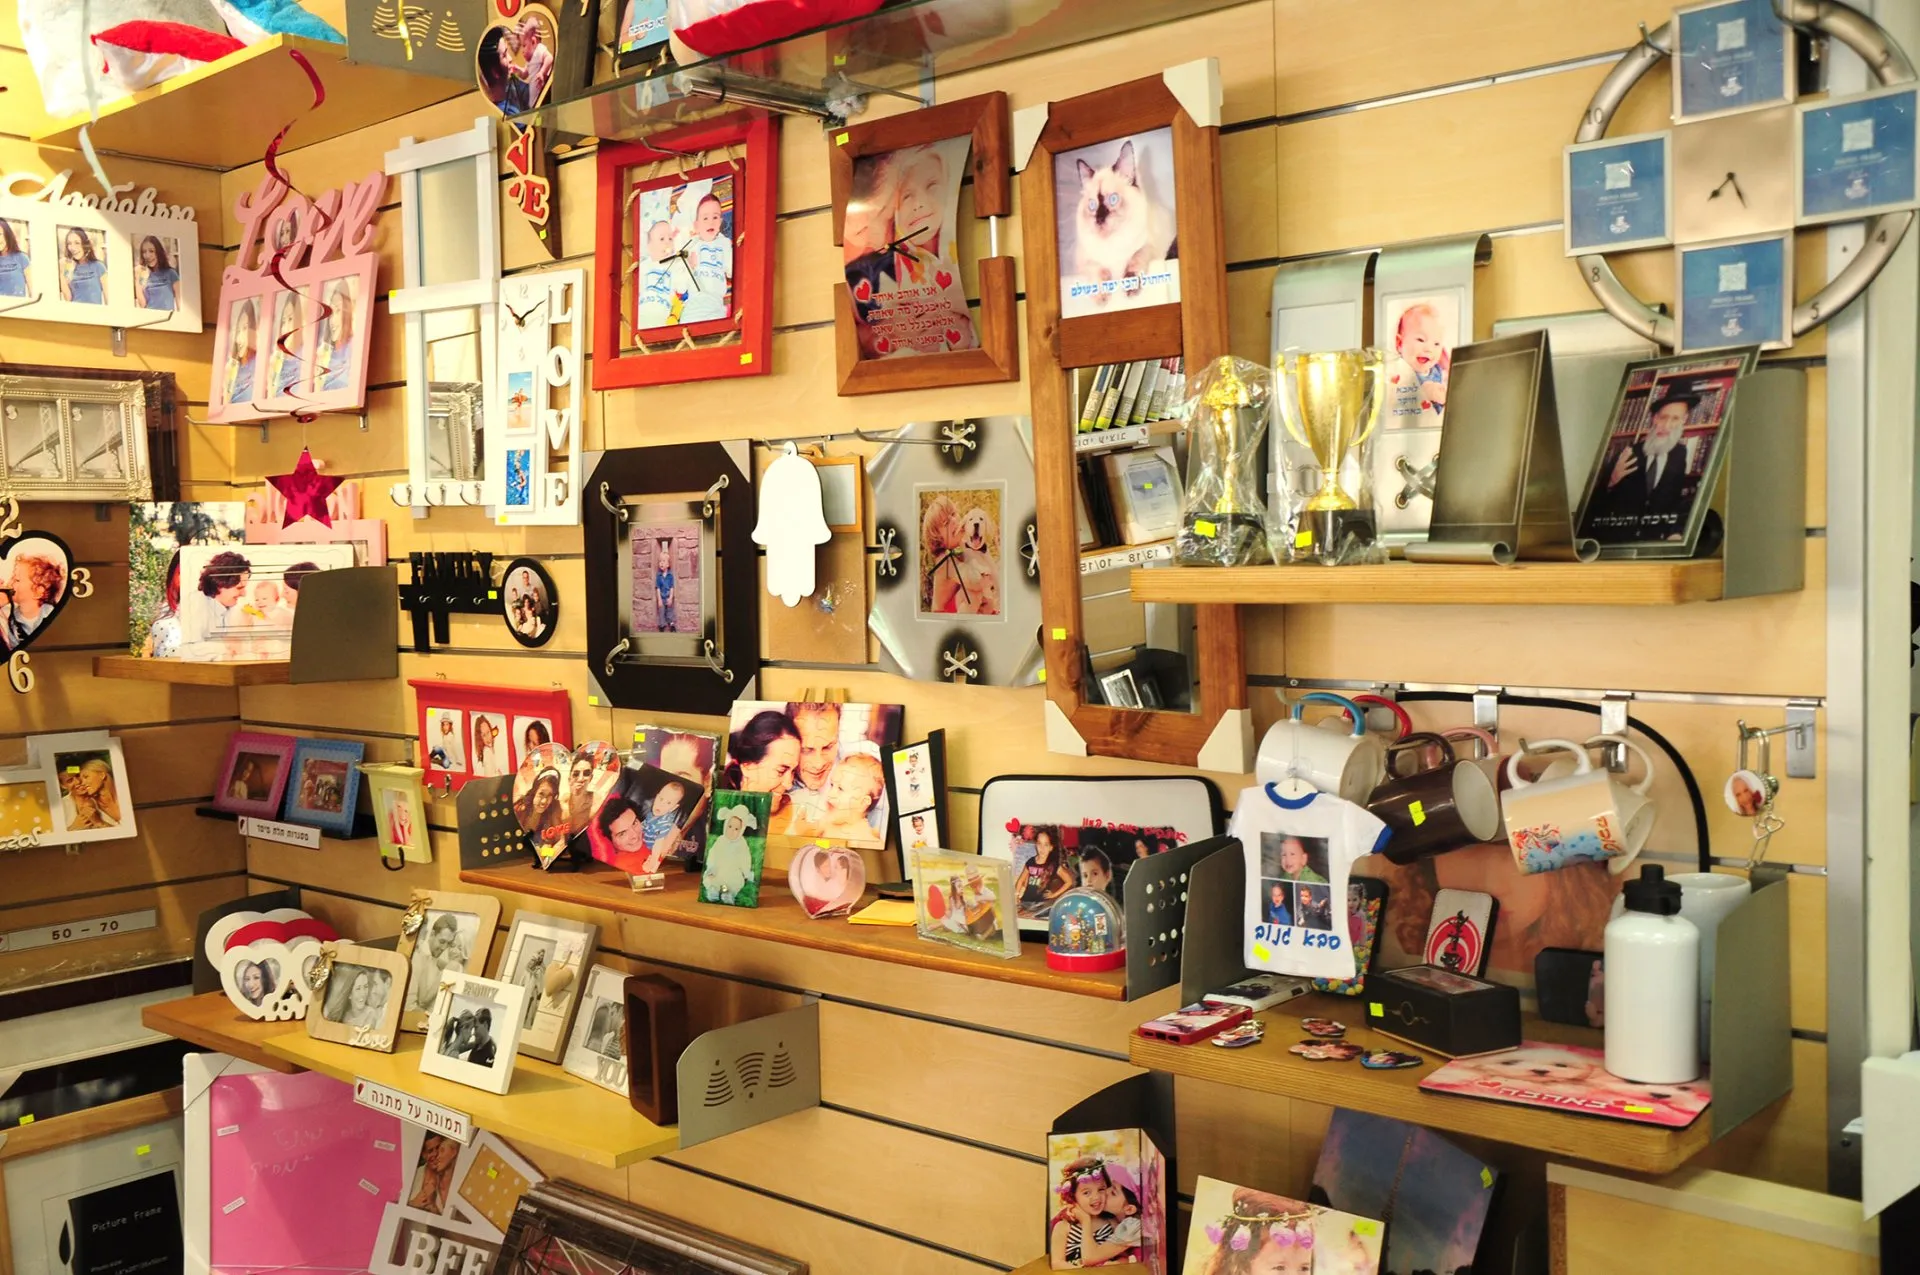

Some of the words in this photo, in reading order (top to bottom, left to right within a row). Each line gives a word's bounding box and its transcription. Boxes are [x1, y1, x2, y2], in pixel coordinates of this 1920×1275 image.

[1071, 281, 1098, 297] בעולם
[1102, 281, 1118, 292] יפה
[1121, 277, 1139, 290] הכי
[1142, 272, 1171, 286] החתול
[922, 286, 937, 297] אני
[543, 283, 574, 512] LOVE
[0, 497, 22, 539] 2
[1592, 511, 1638, 528] והצלחה
[1641, 513, 1678, 525] ברכה
[71, 567, 94, 598] 3
[8, 650, 35, 693] 6
[541, 822, 571, 840] LOVE
[52, 928, 72, 941] 50
[100, 920, 119, 933] 70
[1303, 929, 1341, 950] סבא
[349, 1024, 393, 1049] Love
[595, 1055, 629, 1088] YOU
[371, 1089, 402, 1112] מתנה
[408, 1099, 422, 1119] על
[1499, 1087, 1608, 1110] באהבה
[426, 1110, 462, 1135] תמונה
[91, 1216, 127, 1232] Picture
[134, 1206, 162, 1221] Frame
